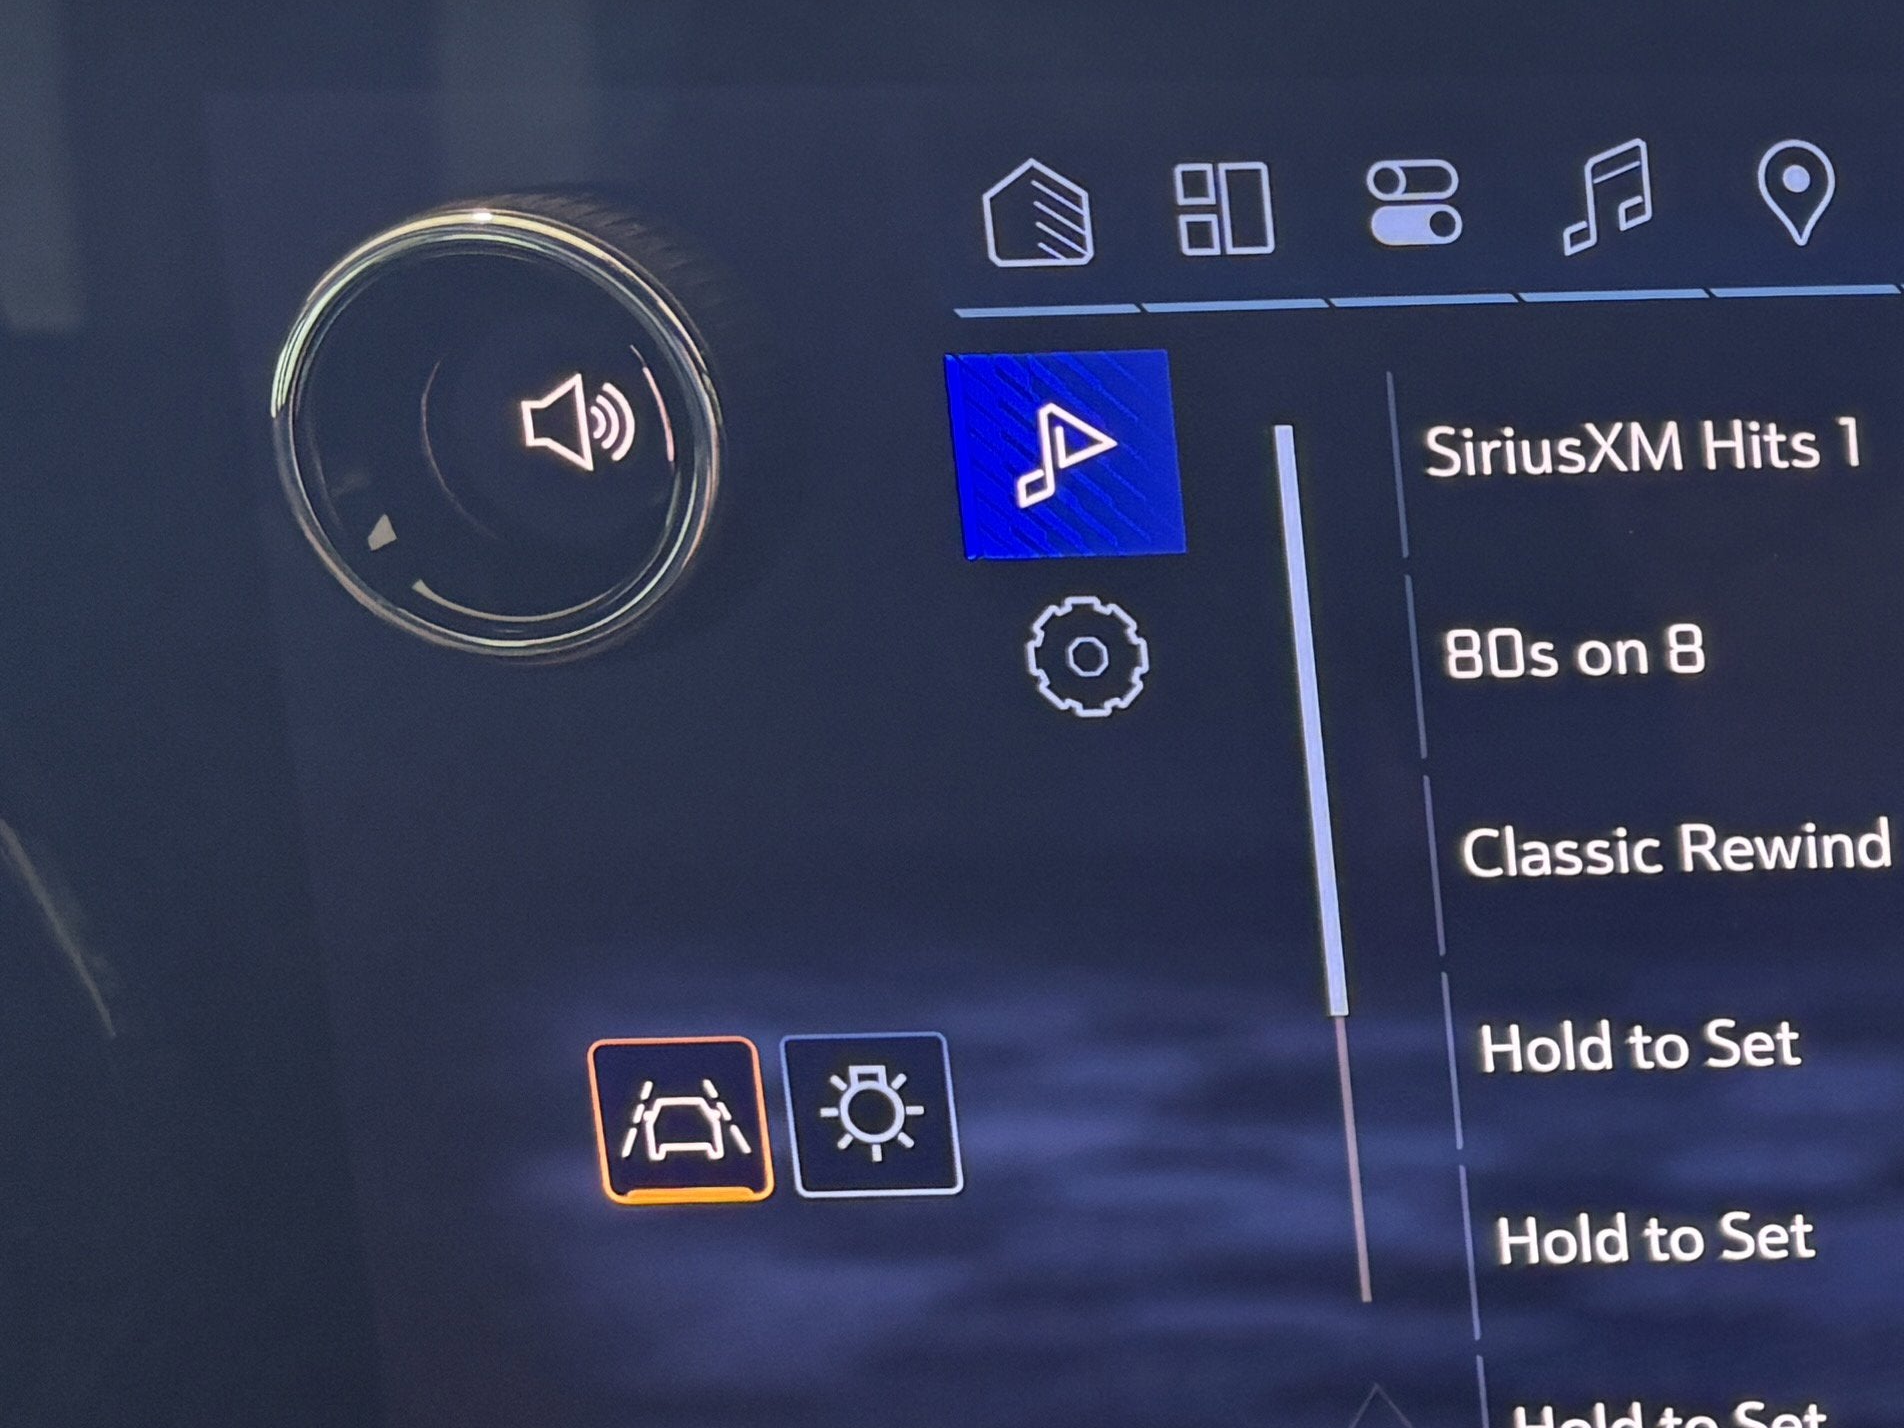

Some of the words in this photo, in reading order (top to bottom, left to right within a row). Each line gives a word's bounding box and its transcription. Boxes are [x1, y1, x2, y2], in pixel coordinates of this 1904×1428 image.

[1426, 420, 1683, 478] SiriusXM
[1702, 418, 1821, 470] Hits
[1838, 416, 1861, 467] 1
[1445, 627, 1559, 679] 80s
[1576, 639, 1649, 677] on
[1666, 623, 1706, 674] 8
[1462, 825, 1664, 878] Classic
[1679, 815, 1892, 873] Rewind
[1481, 1018, 1613, 1073] Hold
[1625, 1024, 1690, 1070] to
[1705, 1018, 1802, 1068] Set
[1497, 1211, 1629, 1265] Hold
[1642, 1217, 1705, 1262] to
[1719, 1210, 1816, 1261] Set
